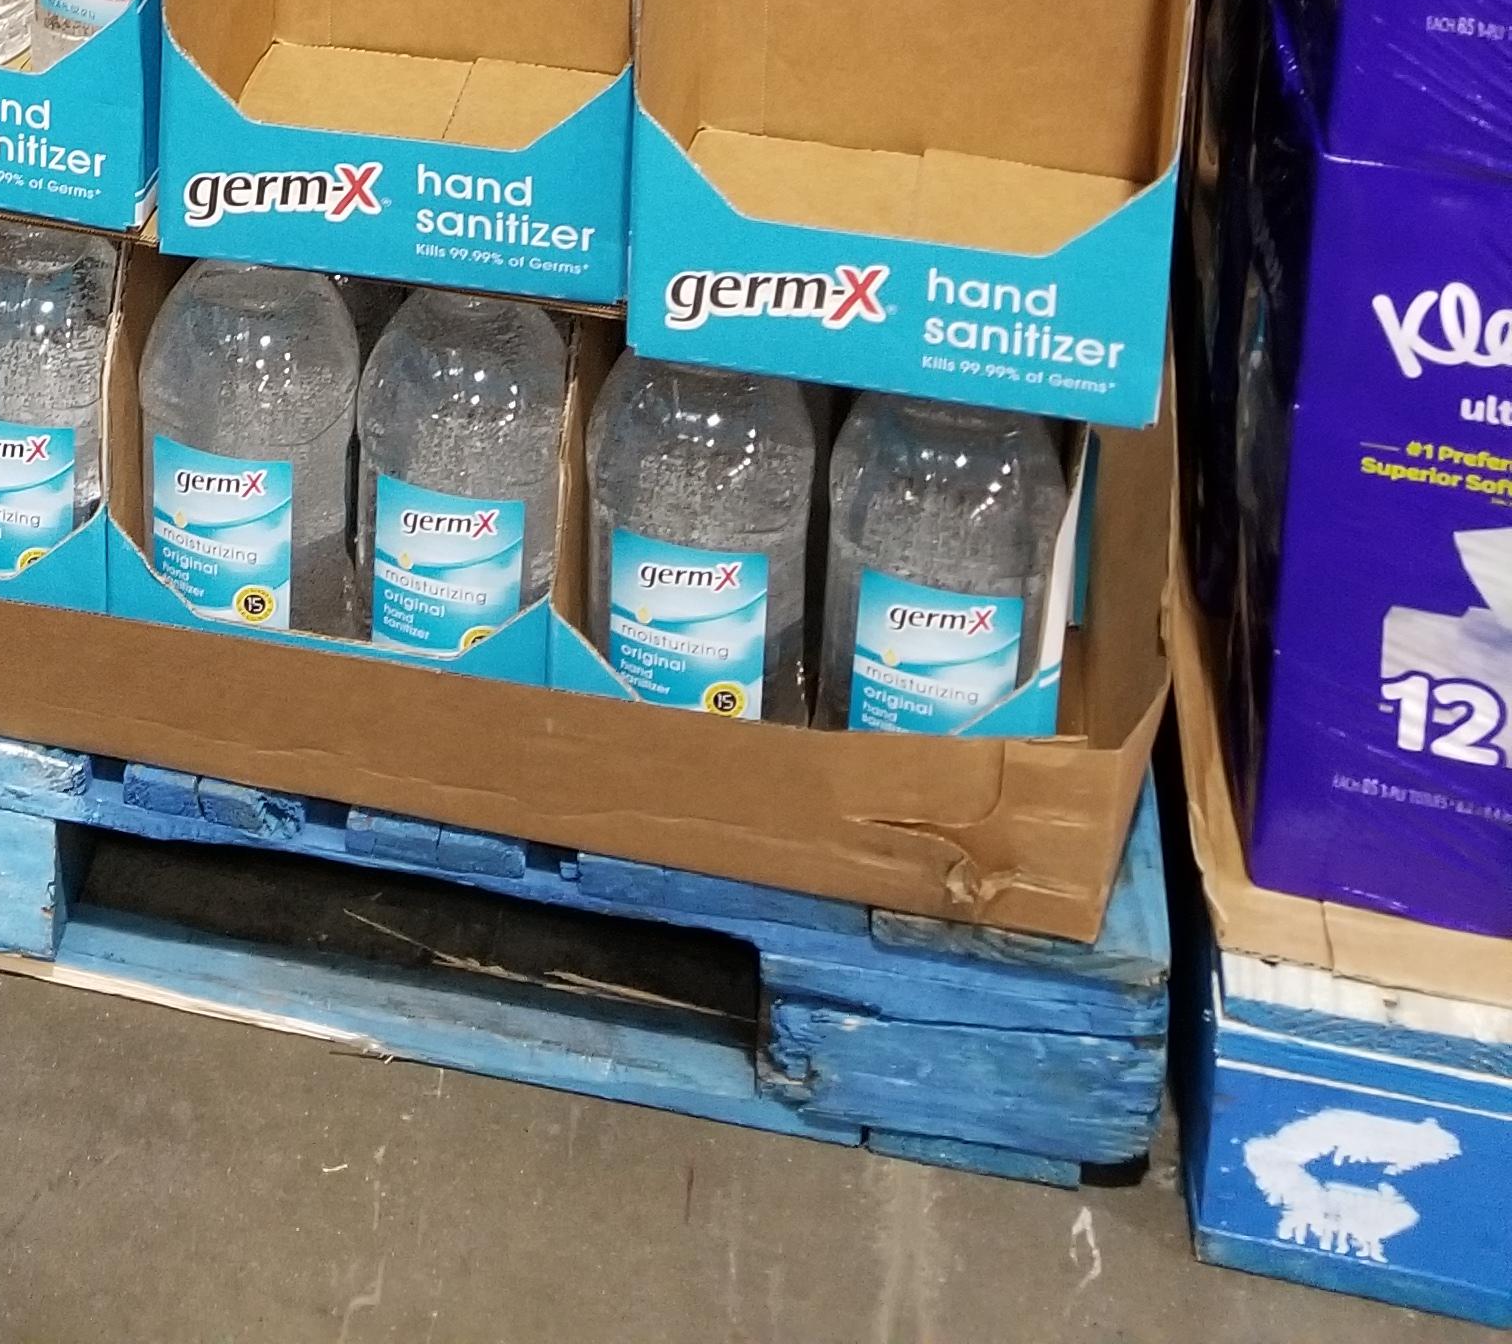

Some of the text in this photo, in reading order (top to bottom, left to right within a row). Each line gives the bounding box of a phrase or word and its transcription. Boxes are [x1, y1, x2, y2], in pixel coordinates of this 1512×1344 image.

[28, 175, 43, 190] of
[188, 165, 377, 220] germ-X
[417, 163, 534, 207] hand
[416, 208, 596, 253] sanitizer
[416, 242, 447, 261] Kills
[449, 246, 504, 267] 99.99%
[508, 255, 525, 269] of
[669, 269, 882, 323] germ-X
[927, 268, 1058, 319] hand
[924, 317, 1126, 370] sanitizer
[922, 355, 956, 374] Kills
[959, 360, 1021, 382] 99.99%
[1406, 441, 1434, 459] #1
[176, 469, 265, 498] germ-X
[1360, 456, 1463, 488] Superior
[402, 509, 497, 539] germ-X
[161, 525, 259, 566] moisturizing
[162, 546, 219, 577] original
[384, 566, 488, 607] moisturizing
[639, 562, 740, 593] germ-X
[245, 595, 264, 614] 15
[383, 604, 415, 626] hand
[384, 588, 446, 620] original
[383, 616, 430, 642] sanitizer
[888, 605, 995, 637] germ-X
[620, 620, 730, 661] moisturizing
[620, 660, 654, 681] hand
[621, 642, 687, 674] original
[865, 660, 980, 706] moisturizing
[716, 692, 735, 709] 15
[863, 683, 934, 718] original
[1381, 675, 1500, 766] 12
